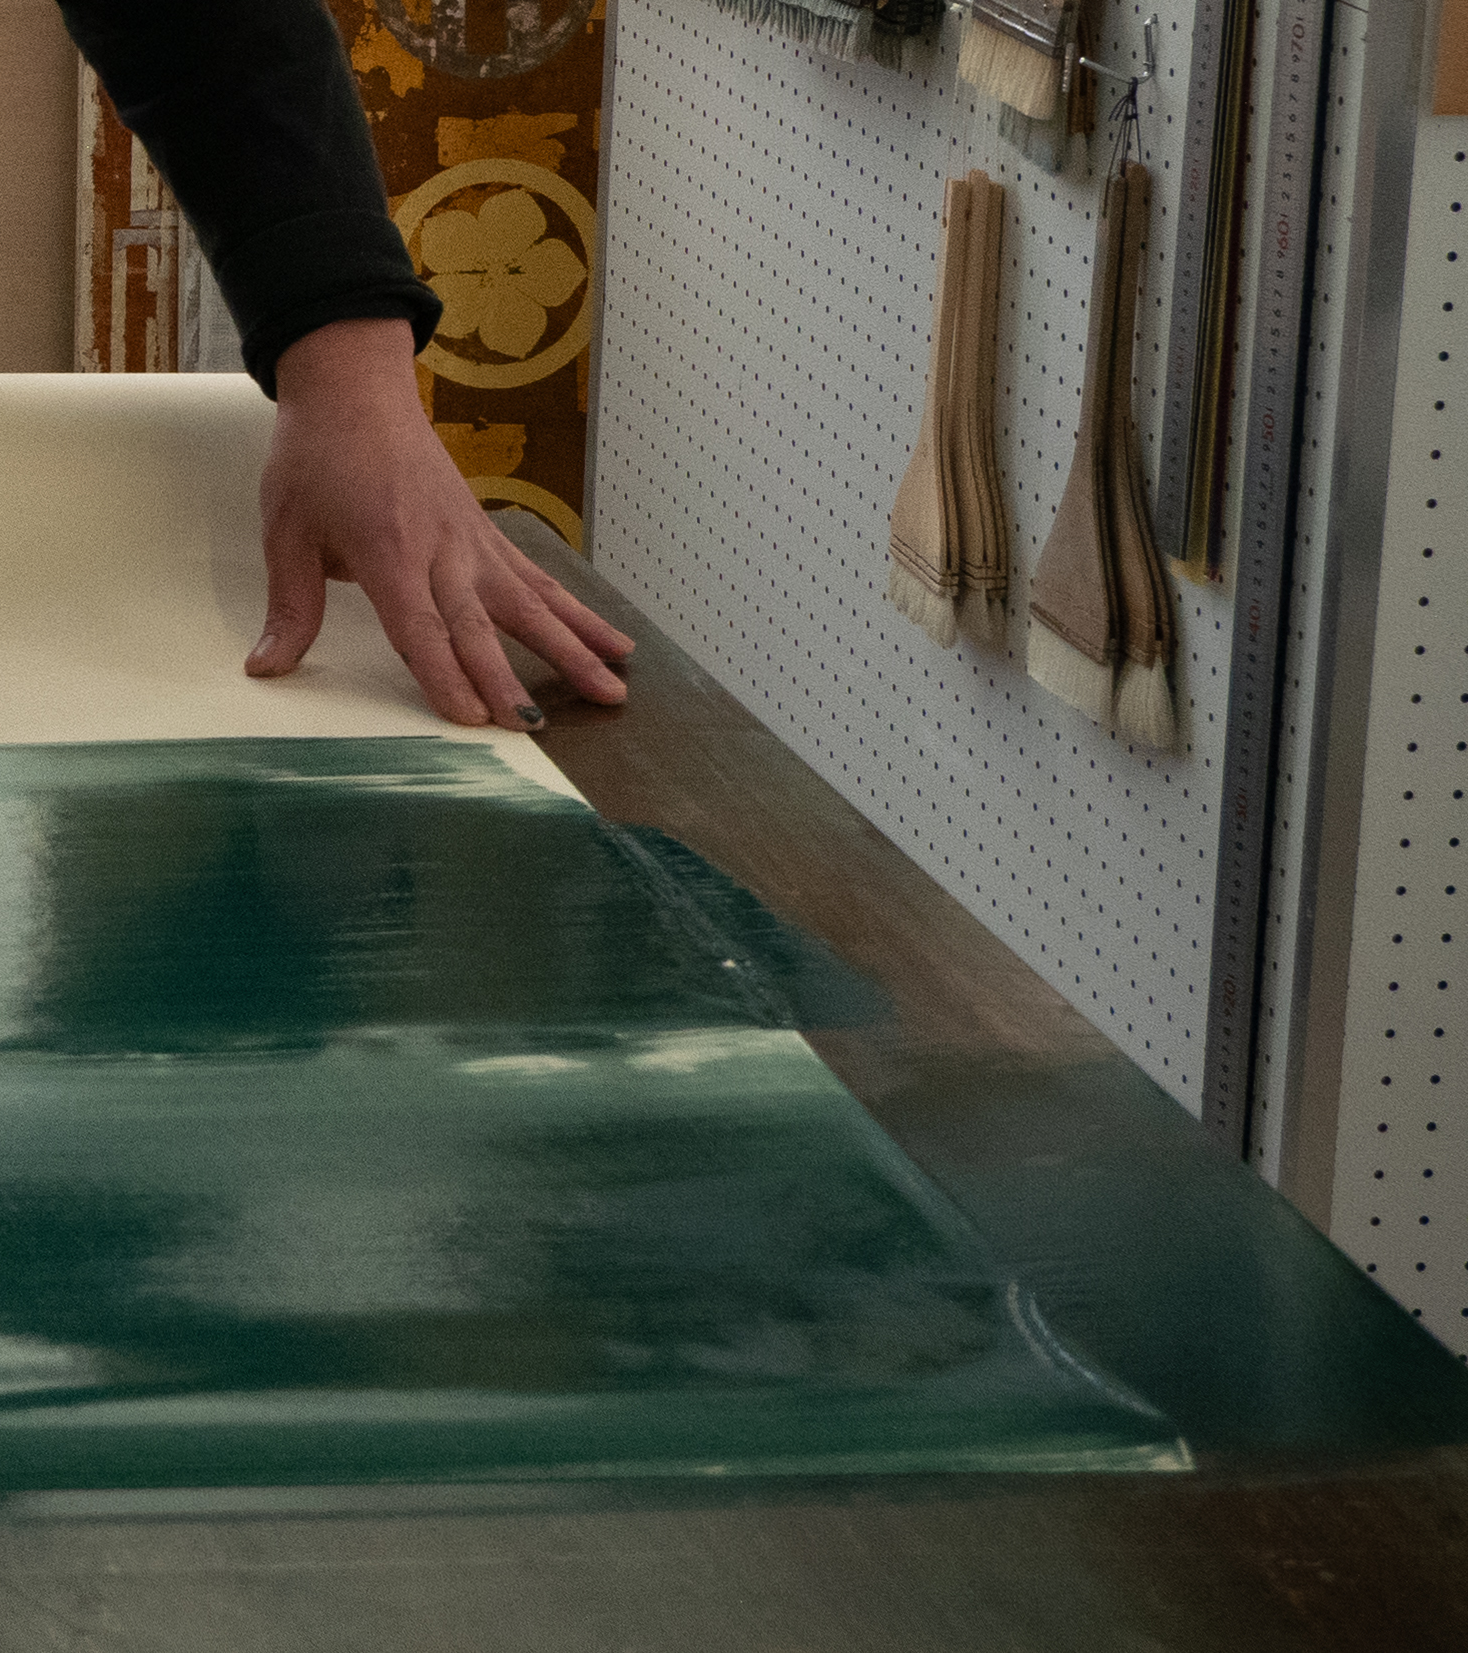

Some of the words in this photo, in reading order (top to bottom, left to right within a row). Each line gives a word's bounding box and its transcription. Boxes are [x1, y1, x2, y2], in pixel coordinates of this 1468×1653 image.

[1291, 23, 1305, 52] 70
[1292, 54, 1301, 63] 9
[1291, 74, 1300, 83] 8
[1288, 93, 1298, 102] 7
[1288, 113, 1297, 123] 6
[1285, 133, 1296, 143] 5
[1285, 153, 1294, 162] 4
[1281, 191, 1291, 201] 2
[1277, 220, 1290, 251] 60
[1277, 250, 1286, 259] 9
[1276, 270, 1285, 279] 8
[1273, 289, 1283, 298] 7
[1273, 309, 1282, 318] 6
[1270, 328, 1281, 338] 5
[1270, 348, 1278, 356] 4
[1268, 367, 1277, 375] 3
[1266, 385, 1276, 395] 2
[1262, 414, 1275, 443] 50
